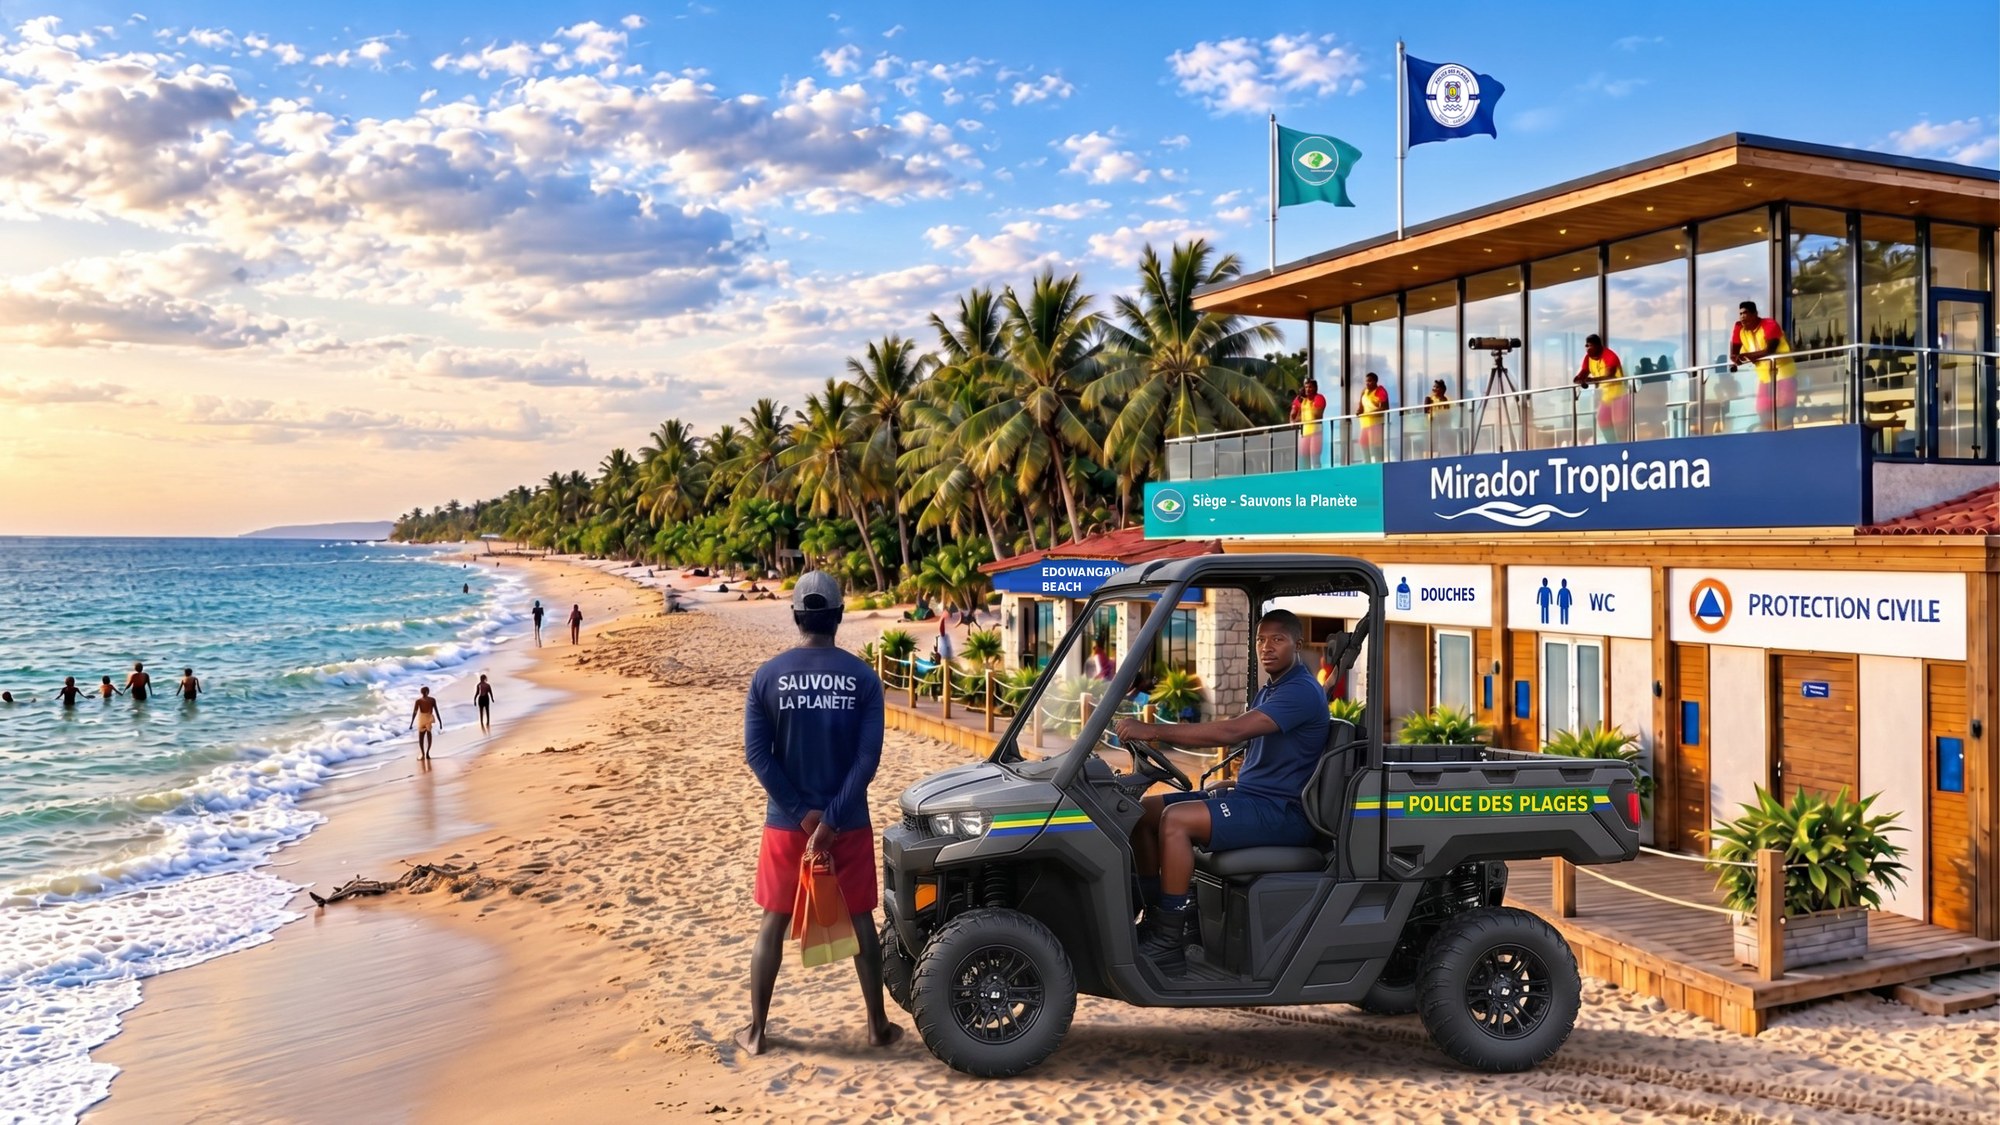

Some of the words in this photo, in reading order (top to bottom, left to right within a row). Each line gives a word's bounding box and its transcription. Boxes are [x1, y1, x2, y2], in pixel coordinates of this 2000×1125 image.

[1430, 459, 1540, 501] Mirador
[1548, 450, 1711, 502] Tropicana
[1193, 494, 1227, 509] Siège
[1240, 494, 1291, 507] Sauvons
[1295, 494, 1306, 507] la
[1311, 494, 1357, 507] Planète
[1042, 566, 1129, 578] EDOWANGAN
[1042, 581, 1082, 592] BEACH
[1421, 587, 1475, 602] DOUCHES
[1589, 593, 1615, 613] WC
[1749, 593, 1870, 620] PROTECTION
[1876, 598, 1941, 623] CIVILE
[778, 674, 857, 692] SAUVONS
[779, 696, 795, 710] LA
[797, 691, 856, 710] PLANÈTE
[1409, 795, 1472, 812] POLICE
[1478, 795, 1513, 812] DES
[1519, 795, 1588, 812] PLAGES
